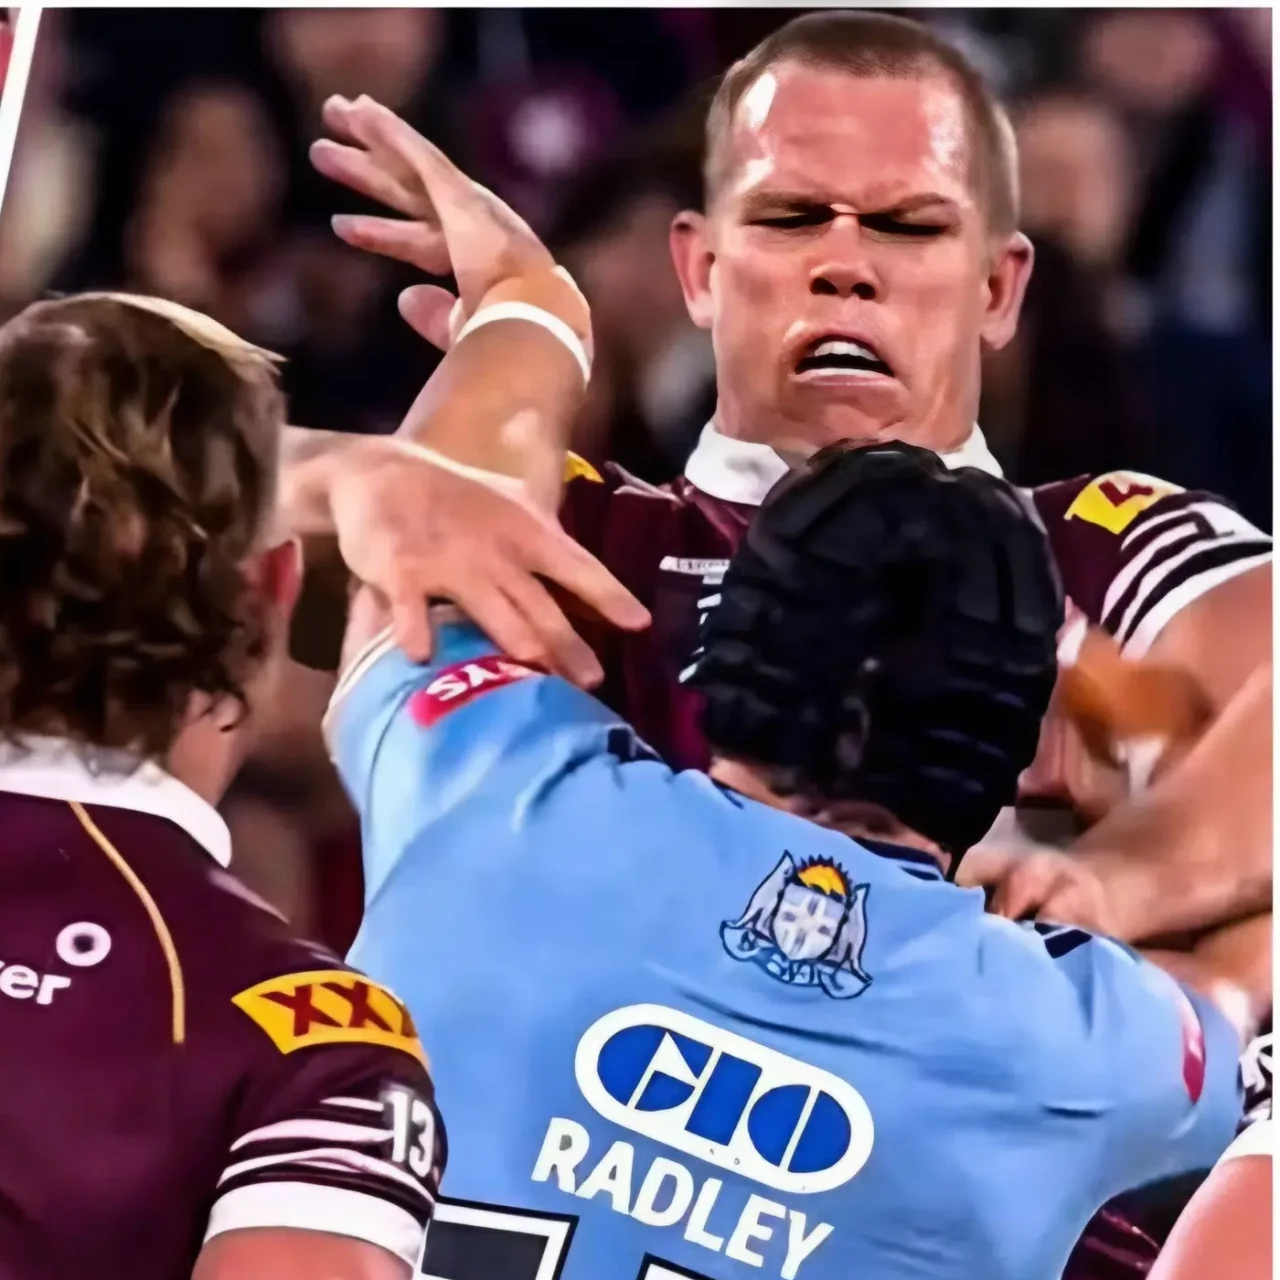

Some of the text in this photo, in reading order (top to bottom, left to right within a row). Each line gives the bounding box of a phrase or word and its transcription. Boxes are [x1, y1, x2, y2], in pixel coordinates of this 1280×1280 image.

[382, 1088, 436, 1178] 13
[597, 1023, 852, 1174] GIO
[531, 1117, 835, 1280] RADLEY
